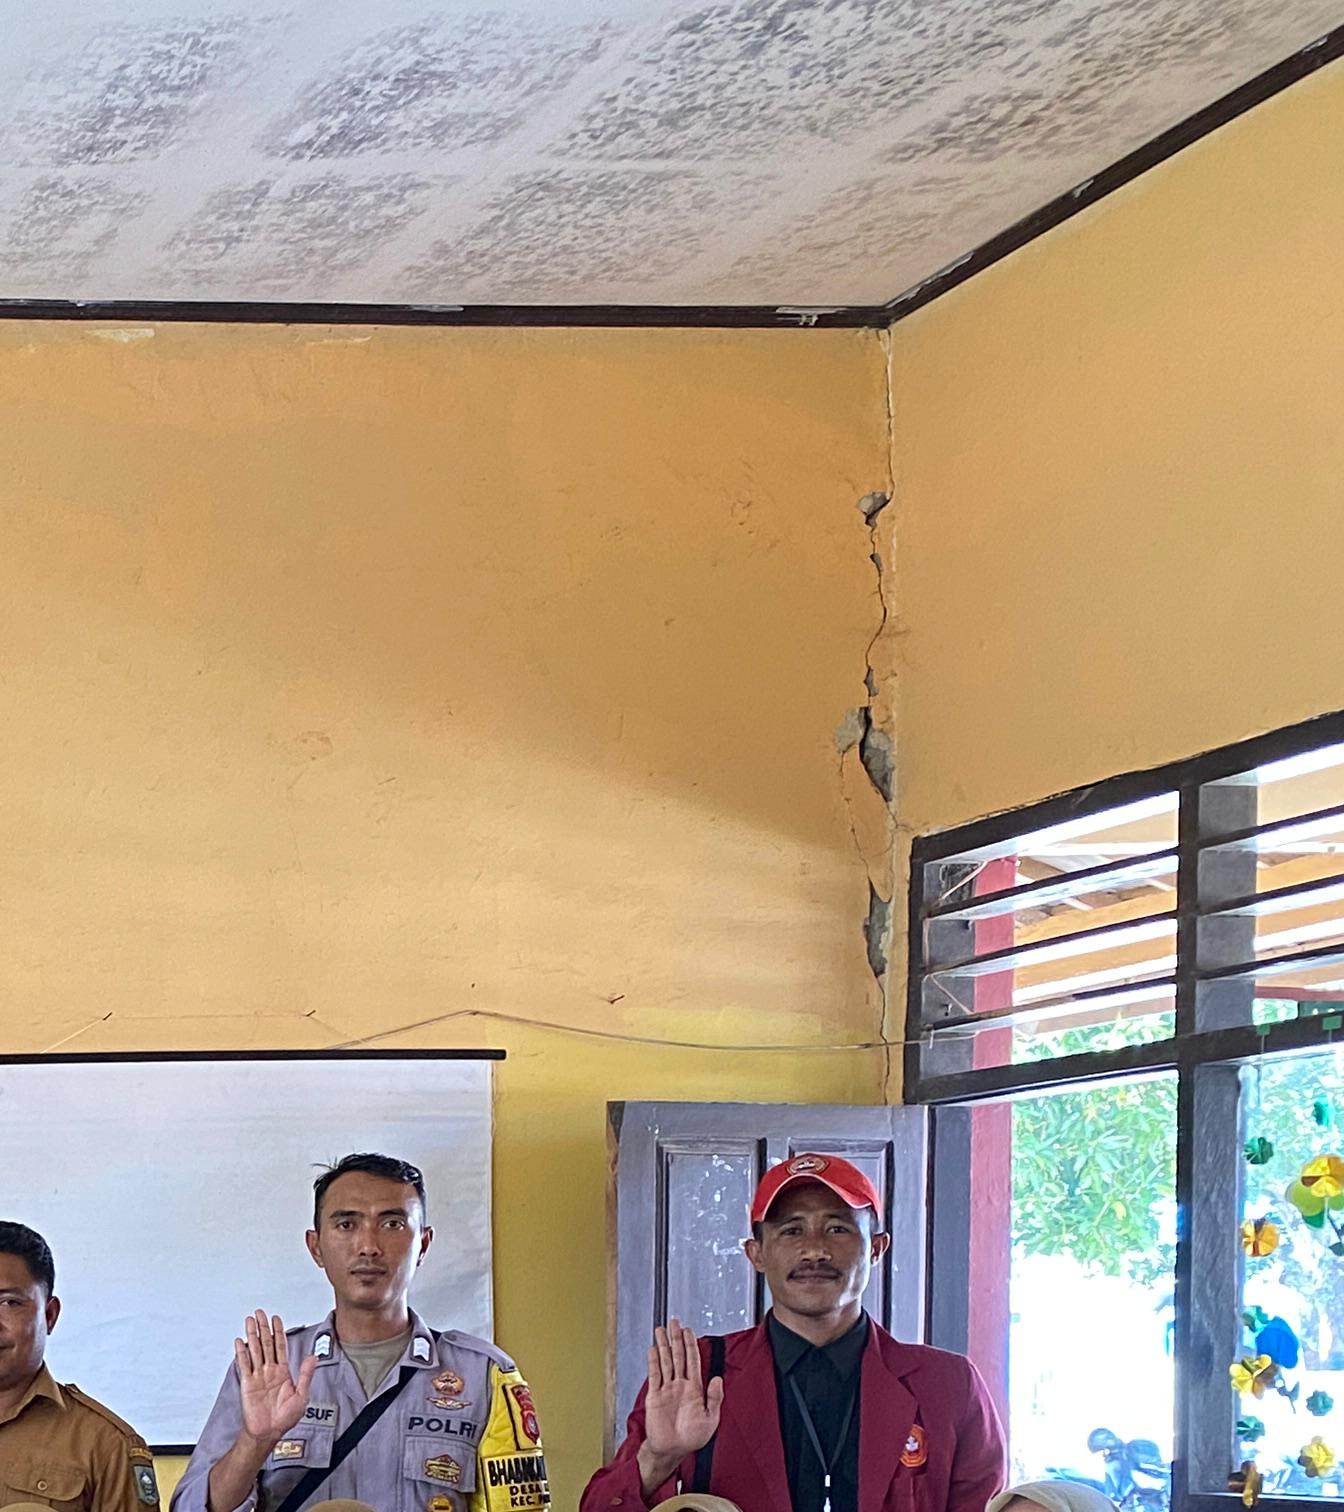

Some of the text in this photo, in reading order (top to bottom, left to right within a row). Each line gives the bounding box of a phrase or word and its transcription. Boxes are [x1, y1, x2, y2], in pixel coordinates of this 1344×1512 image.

[305, 1407, 334, 1421] SUF
[408, 1416, 478, 1440] POLRI
[509, 1483, 542, 1496] DESA
